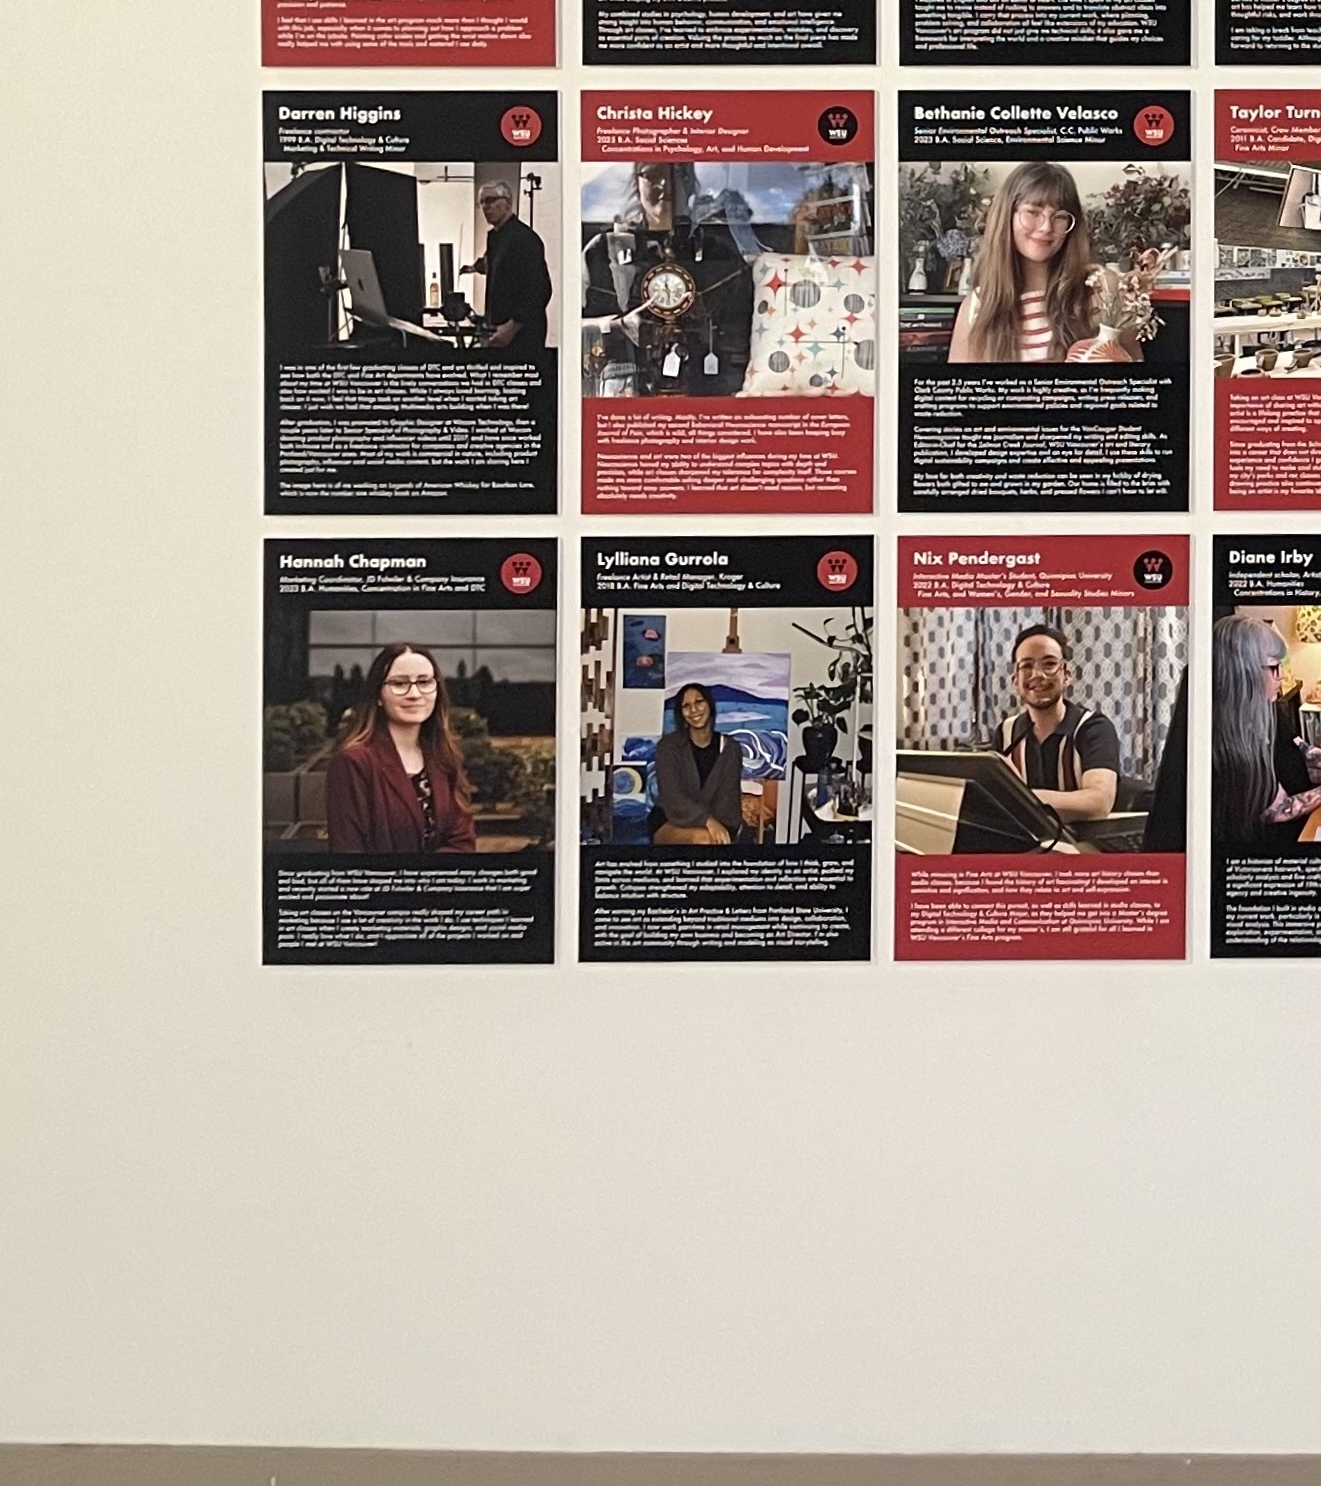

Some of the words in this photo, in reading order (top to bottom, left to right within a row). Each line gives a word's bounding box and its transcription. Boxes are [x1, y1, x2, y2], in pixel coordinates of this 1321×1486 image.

[279, 107, 335, 120] Darren
[340, 106, 400, 123] Higgins
[597, 106, 653, 119] Christa
[658, 106, 713, 123] Hickey
[915, 106, 985, 119] Bethanie
[990, 106, 1052, 119] Collette
[1056, 106, 1118, 119] Velasco
[1230, 105, 1282, 122] Taylor
[280, 554, 344, 568] Hannah
[349, 554, 426, 571] Chapman
[598, 552, 660, 569] Lylliana
[665, 552, 728, 565] Gurrola
[914, 551, 943, 564] Nix
[949, 551, 1040, 568] Pendergast
[1230, 550, 1275, 563] Diane
[1281, 549, 1313, 567] Irby
